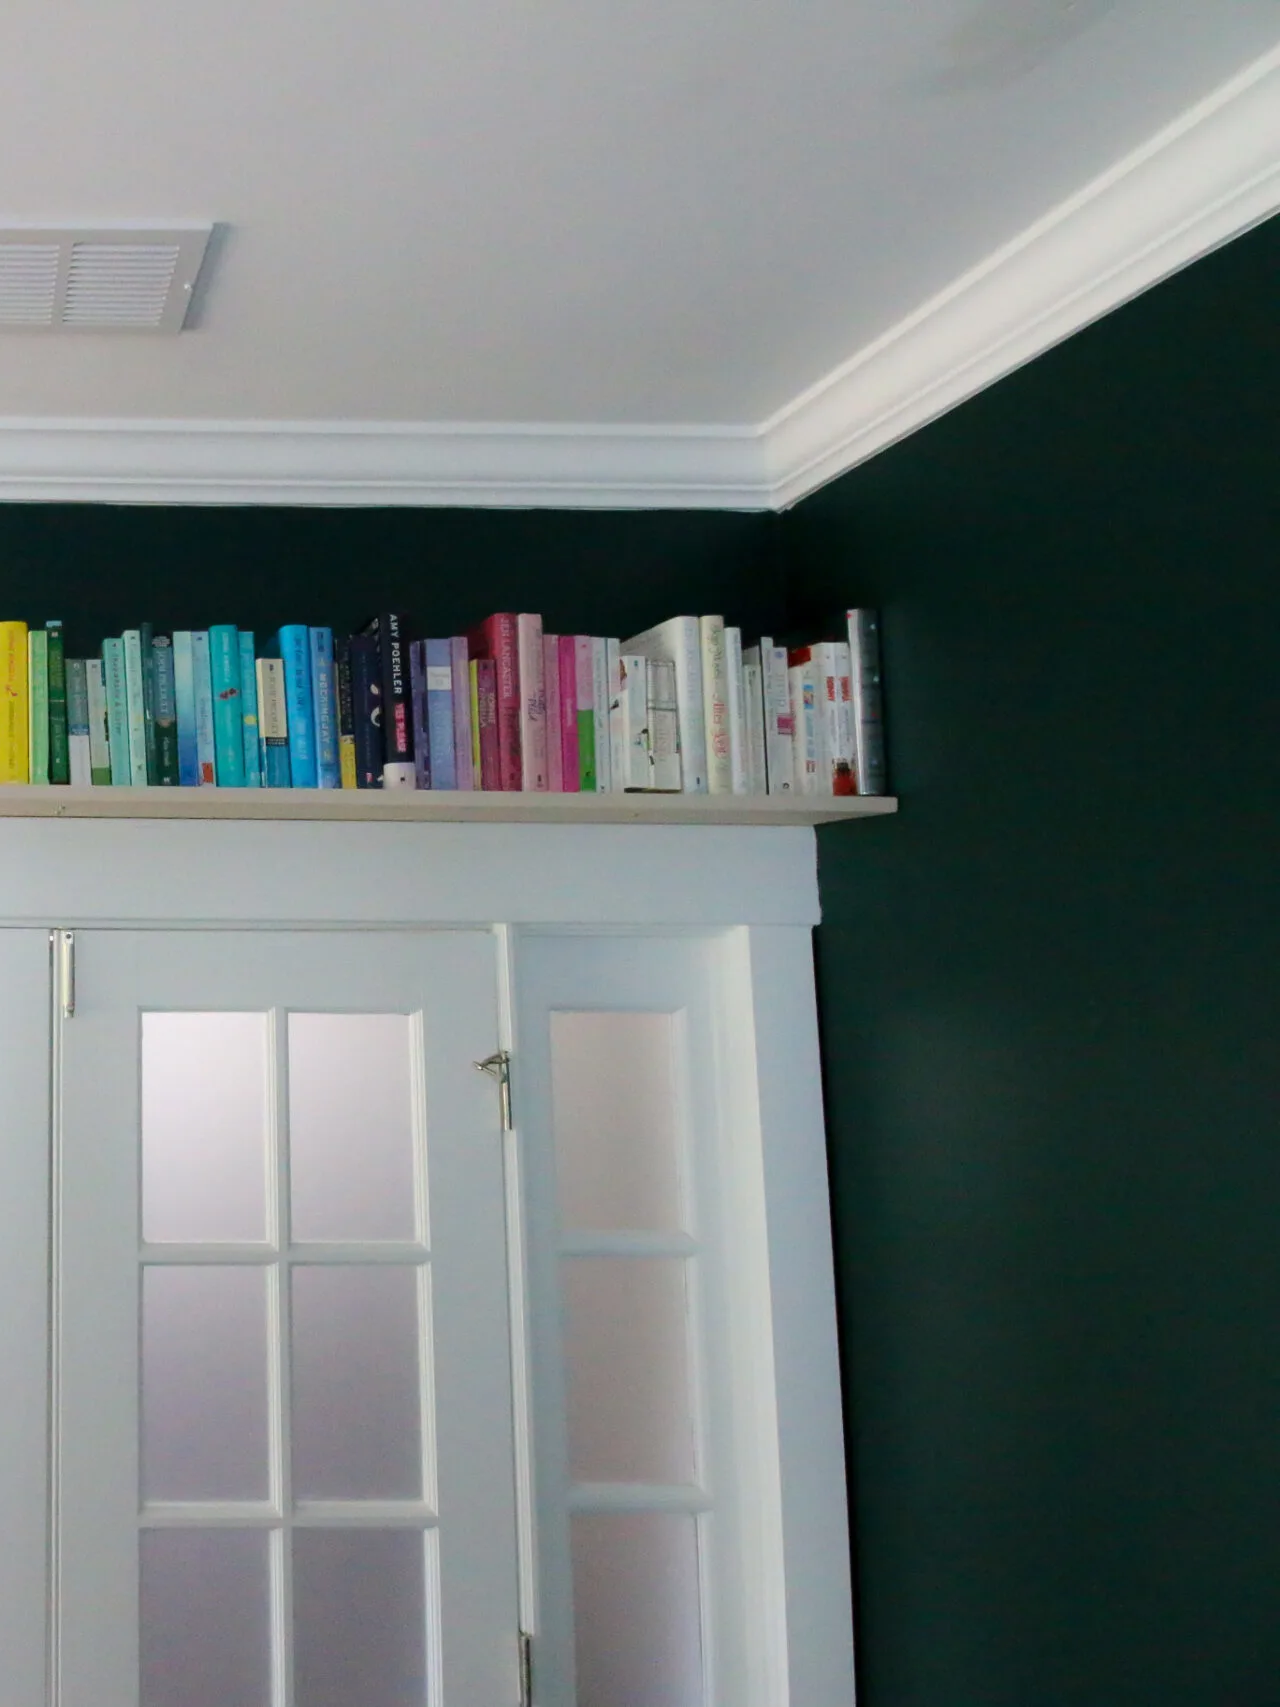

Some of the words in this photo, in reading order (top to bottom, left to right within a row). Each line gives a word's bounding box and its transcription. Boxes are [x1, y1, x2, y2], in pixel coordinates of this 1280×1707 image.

[389, 613, 398, 638] AMY
[501, 618, 509, 637] JEN
[391, 642, 402, 695] POEHLER
[502, 640, 512, 699] LANCASTER
[319, 672, 330, 744] MOCKINGJAY
[394, 703, 405, 720] YES
[395, 721, 407, 753] PLEASE
